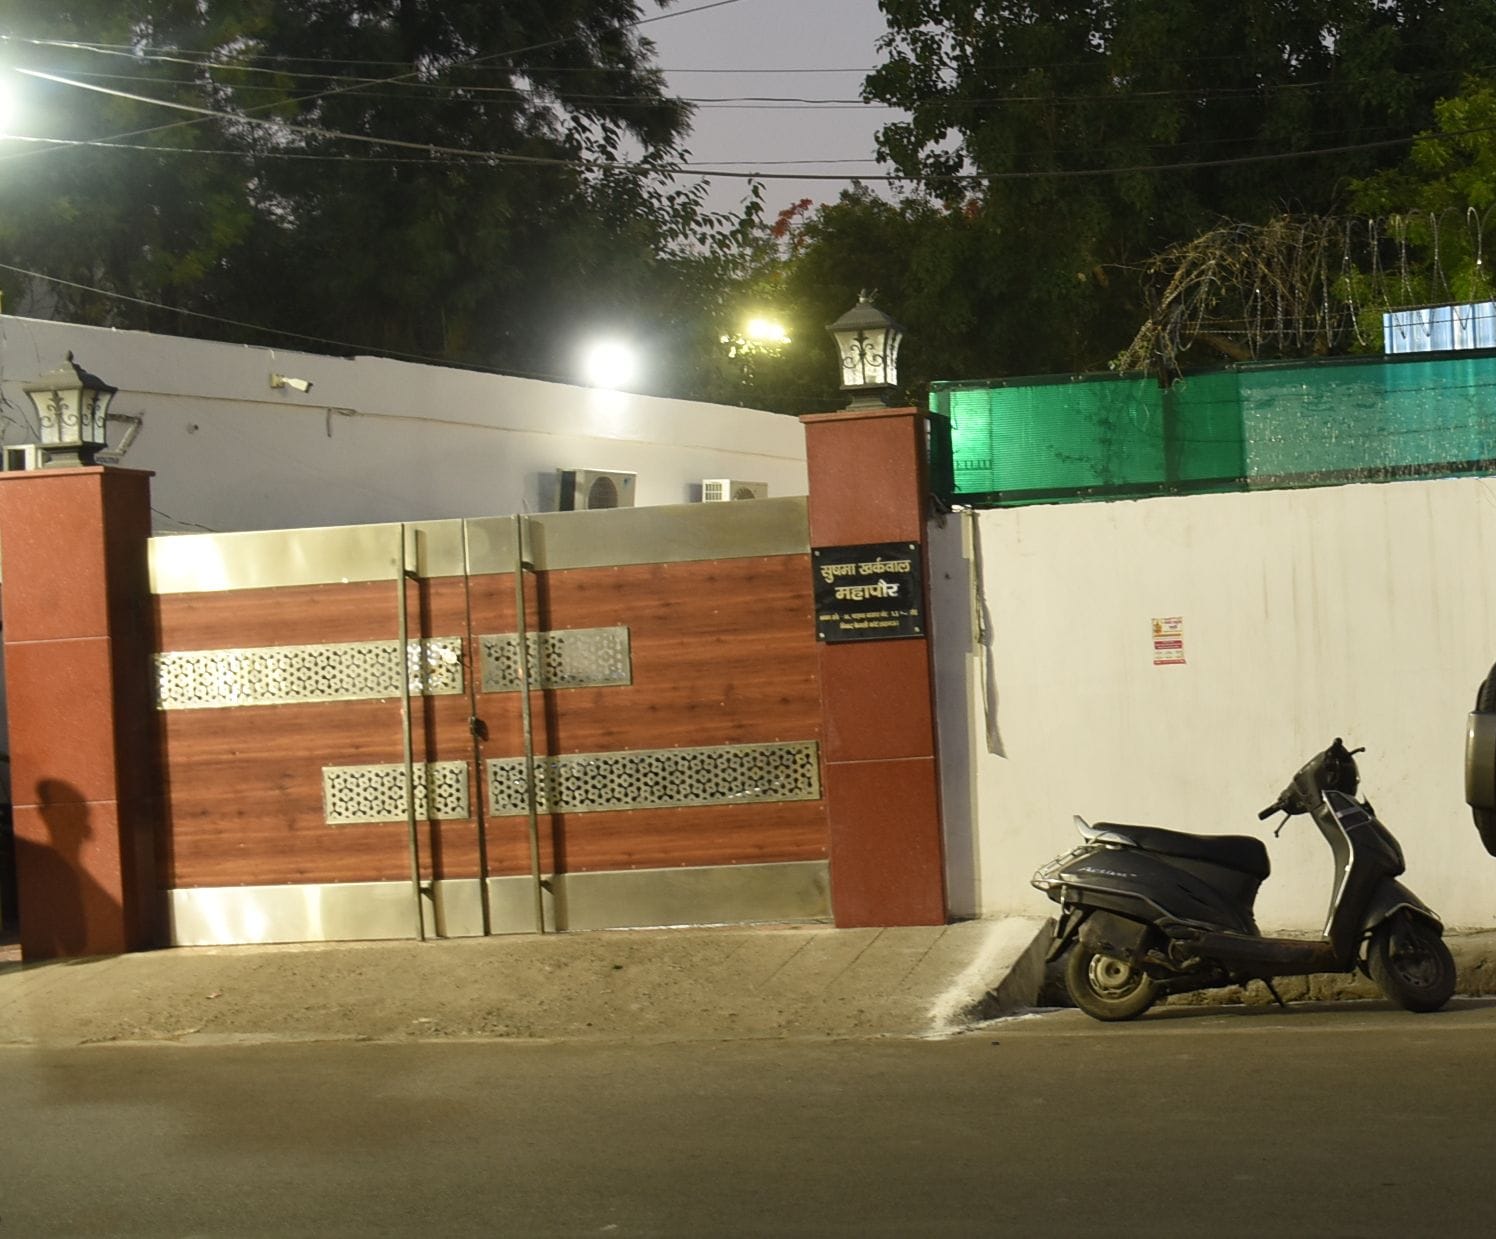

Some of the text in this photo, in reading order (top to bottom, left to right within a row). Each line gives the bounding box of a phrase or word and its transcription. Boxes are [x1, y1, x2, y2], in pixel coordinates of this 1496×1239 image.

[820, 557, 912, 584] सुषमा खर्कवाल
[834, 579, 901, 601] महापौर
